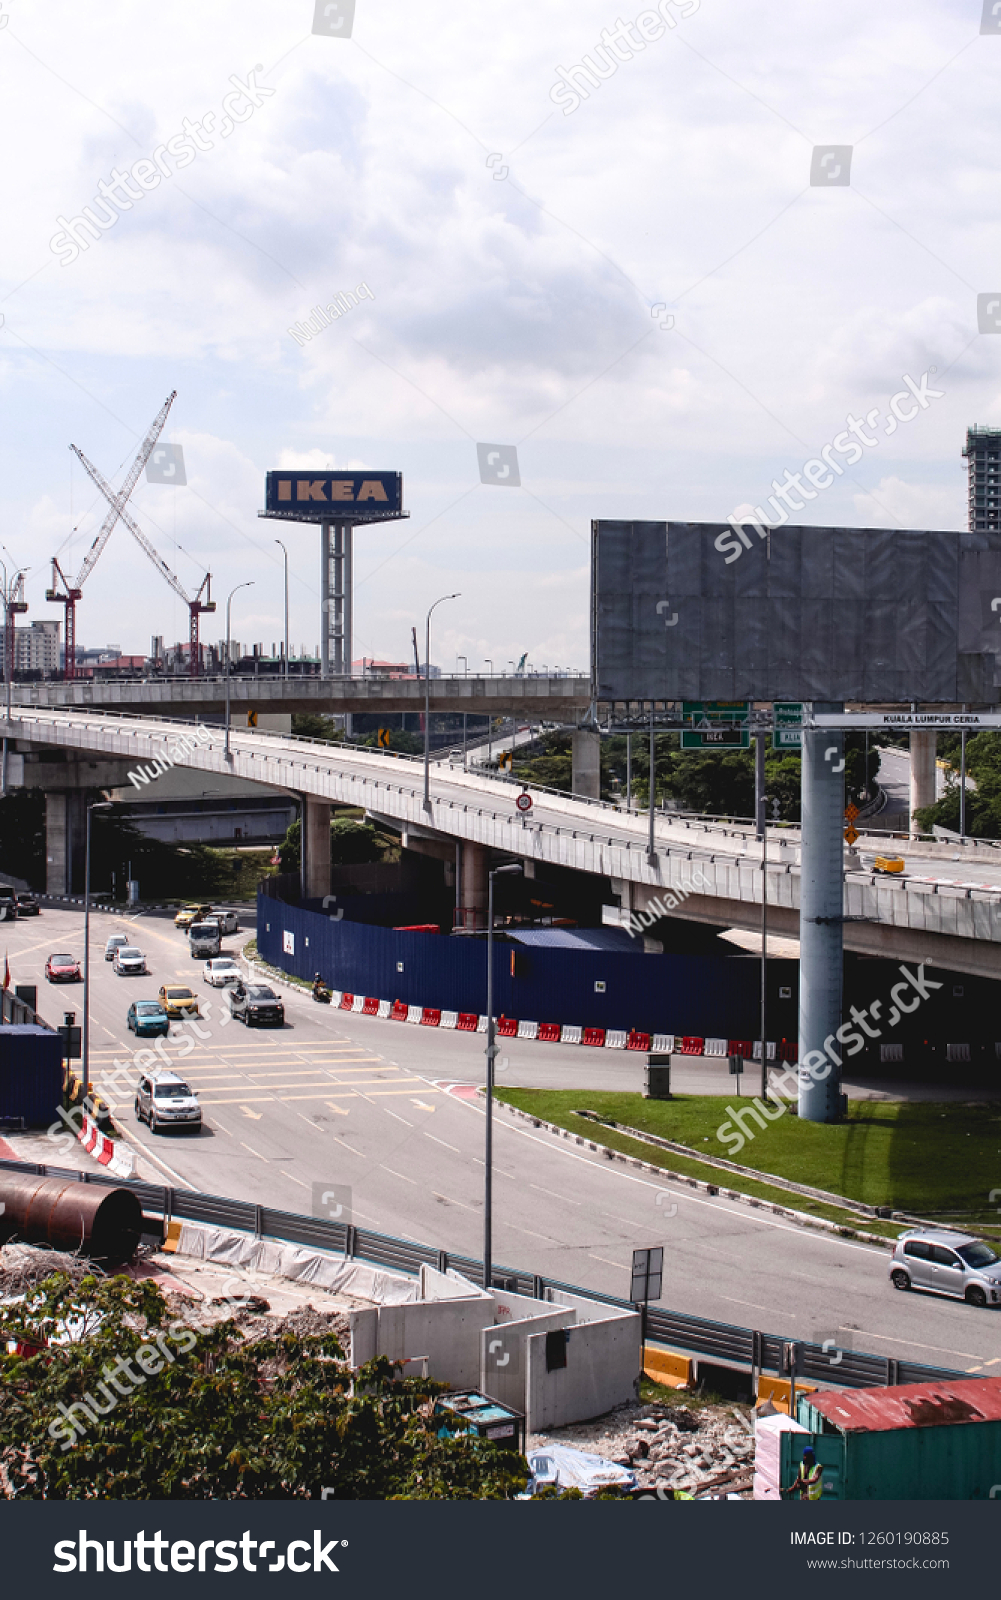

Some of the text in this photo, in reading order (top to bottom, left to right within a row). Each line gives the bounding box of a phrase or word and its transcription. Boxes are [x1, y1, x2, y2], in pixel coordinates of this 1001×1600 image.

[277, 479, 390, 502] IKEA
[883, 714, 980, 724] KUALA LUMPUR CERIA
